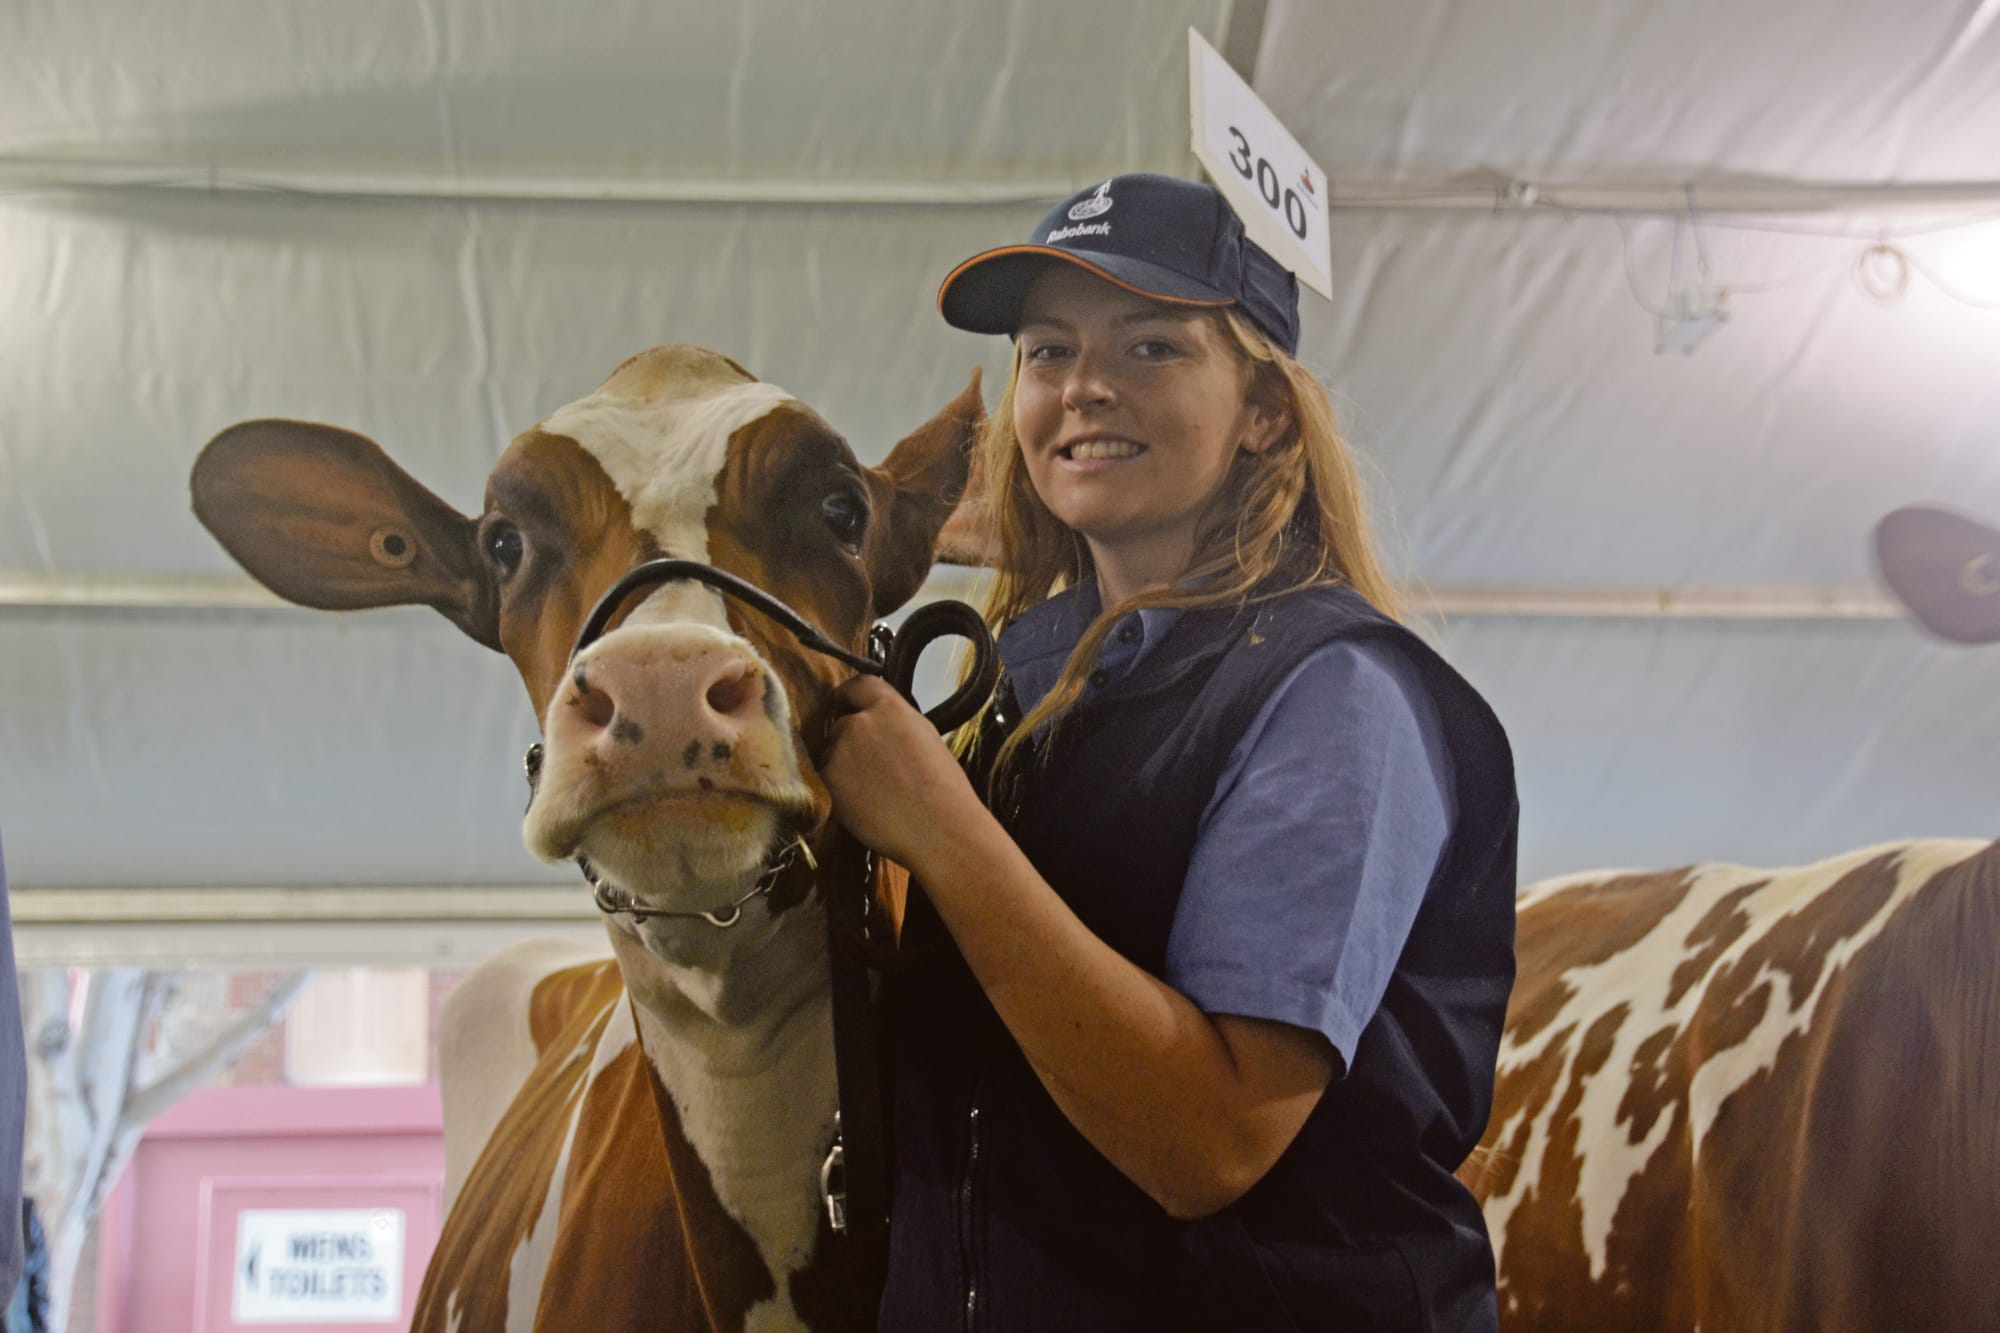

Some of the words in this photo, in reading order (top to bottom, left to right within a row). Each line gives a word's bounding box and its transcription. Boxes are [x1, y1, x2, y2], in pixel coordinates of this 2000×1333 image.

[1228, 126, 1307, 240] 300
[1046, 221, 1111, 244] Rabobank
[268, 1269, 387, 1300] TOILETS
